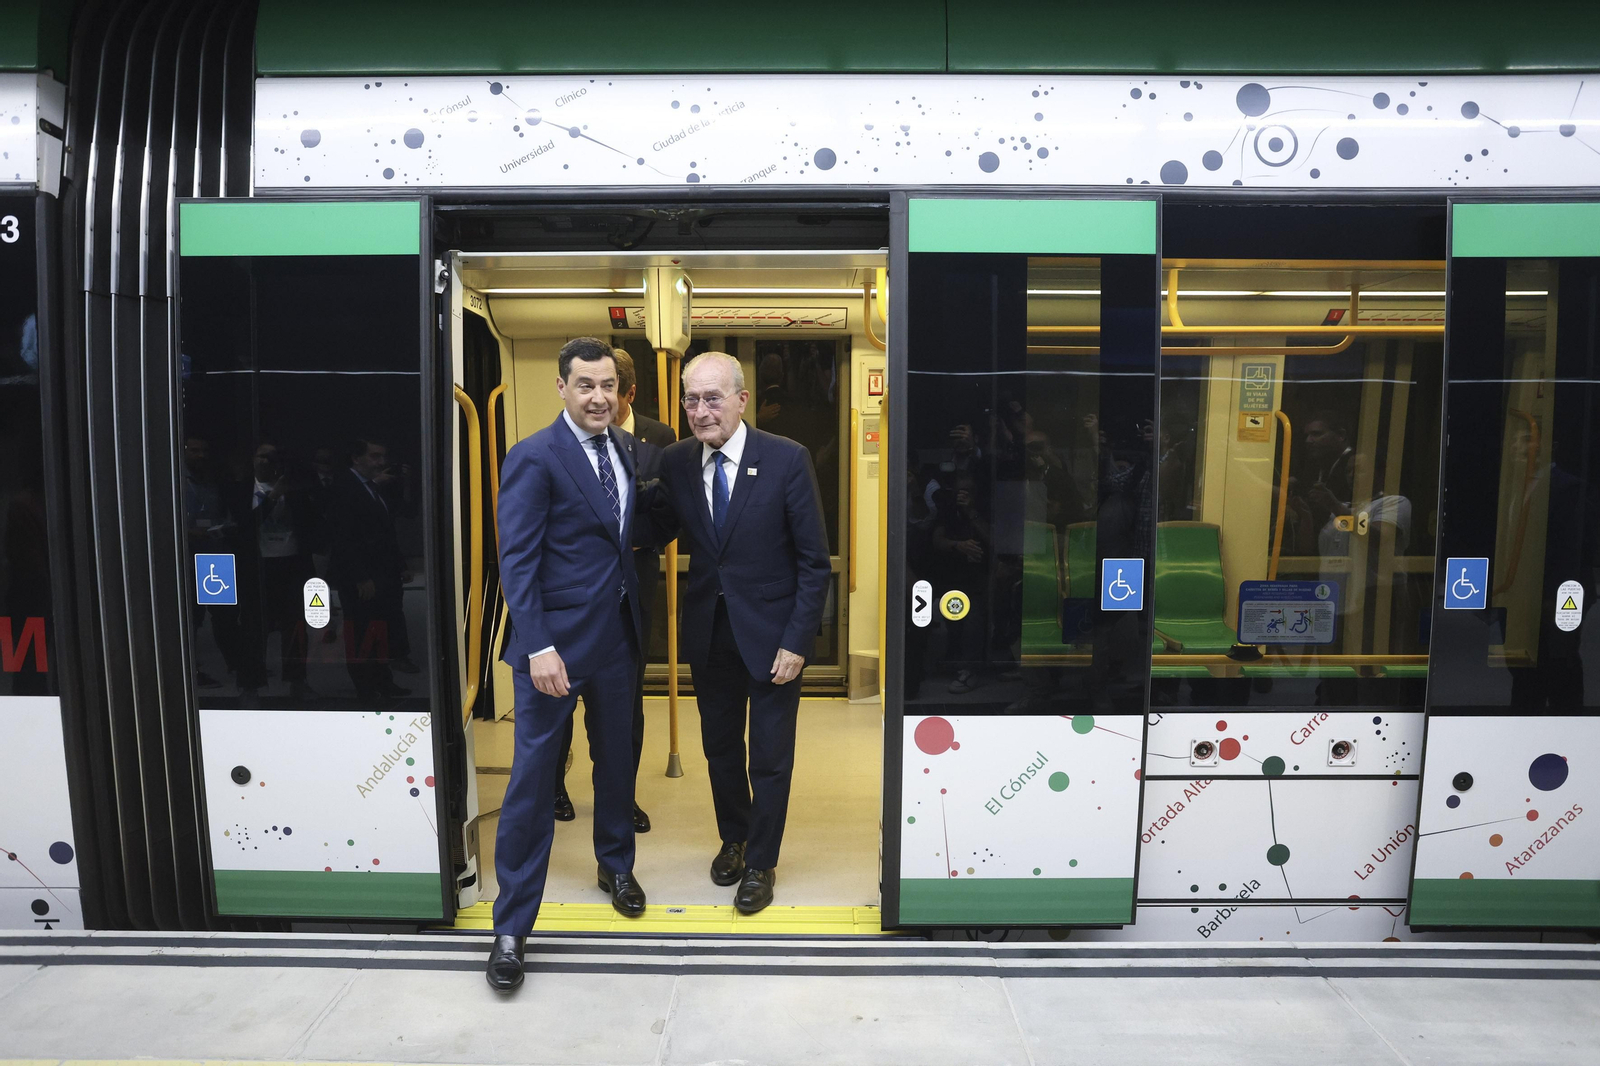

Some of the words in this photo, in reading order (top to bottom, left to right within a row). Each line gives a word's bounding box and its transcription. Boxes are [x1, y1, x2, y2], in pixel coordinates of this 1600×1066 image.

[554, 88, 587, 108] Clínico
[652, 130, 686, 152] Ciudad
[687, 124, 700, 134] de
[700, 118, 710, 128] la
[712, 100, 746, 122] sticia
[499, 139, 555, 174] Universidad
[0, 214, 20, 244] 3
[470, 294, 482, 310] 3072
[356, 732, 418, 798] Andalucía
[984, 797, 1003, 816] El
[1000, 751, 1048, 800] Cónsul
[1354, 863, 1375, 880] La
[1372, 824, 1414, 862] Unión
[1505, 804, 1583, 876] Atarazanas
